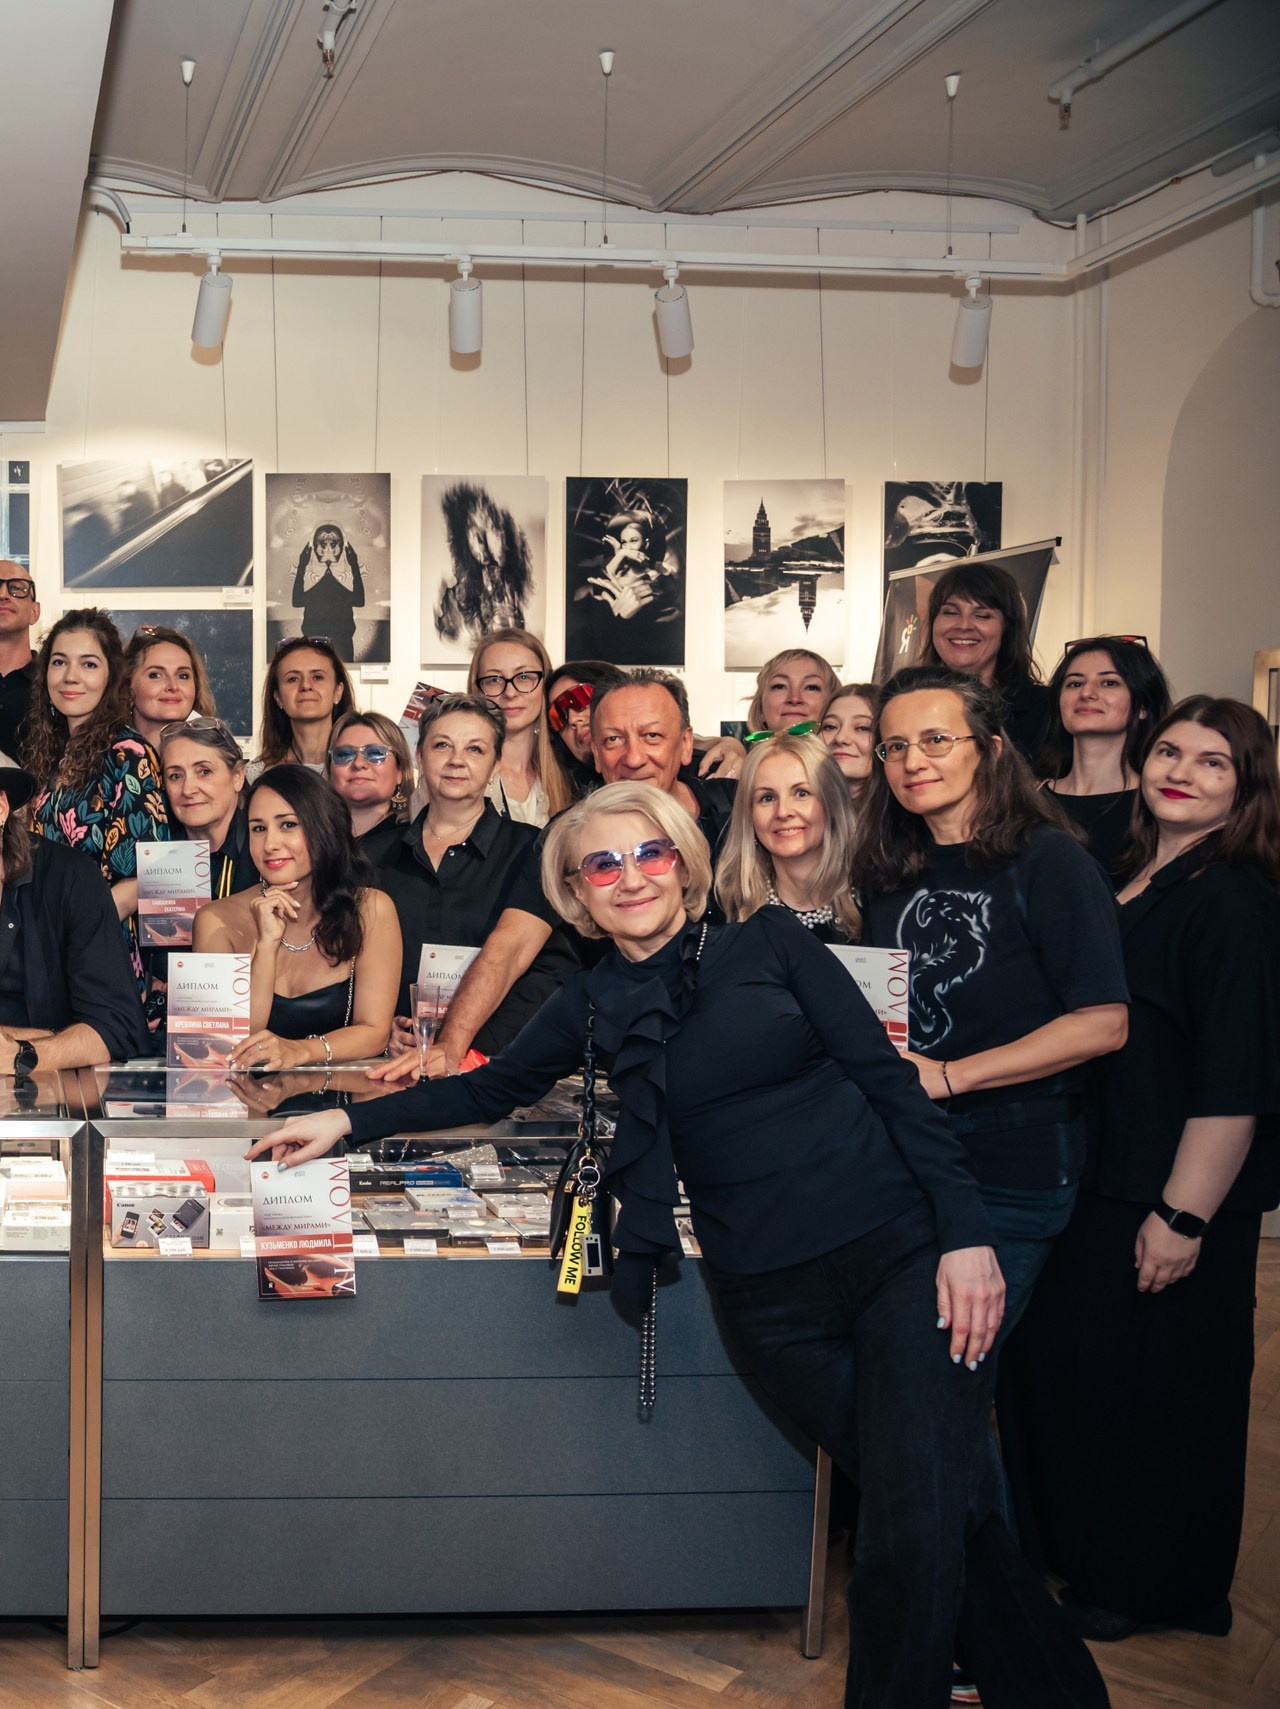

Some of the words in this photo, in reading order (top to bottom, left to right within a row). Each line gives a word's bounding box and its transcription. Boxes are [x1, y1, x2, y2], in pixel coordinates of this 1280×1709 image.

[144, 867, 182, 876] ДИПЛОМ
[175, 982, 218, 990] ДИПЛОМ
[202, 1021, 230, 1029] СВЕТЛАНА
[262, 1194, 313, 1206] ДИПЛОМ
[260, 1240, 298, 1250] КУЗЬМЕНКО
[298, 1238, 332, 1249] ЛЮДМИЛА
[569, 1215, 587, 1265] FOLLOW
[564, 1266, 578, 1286] ME
